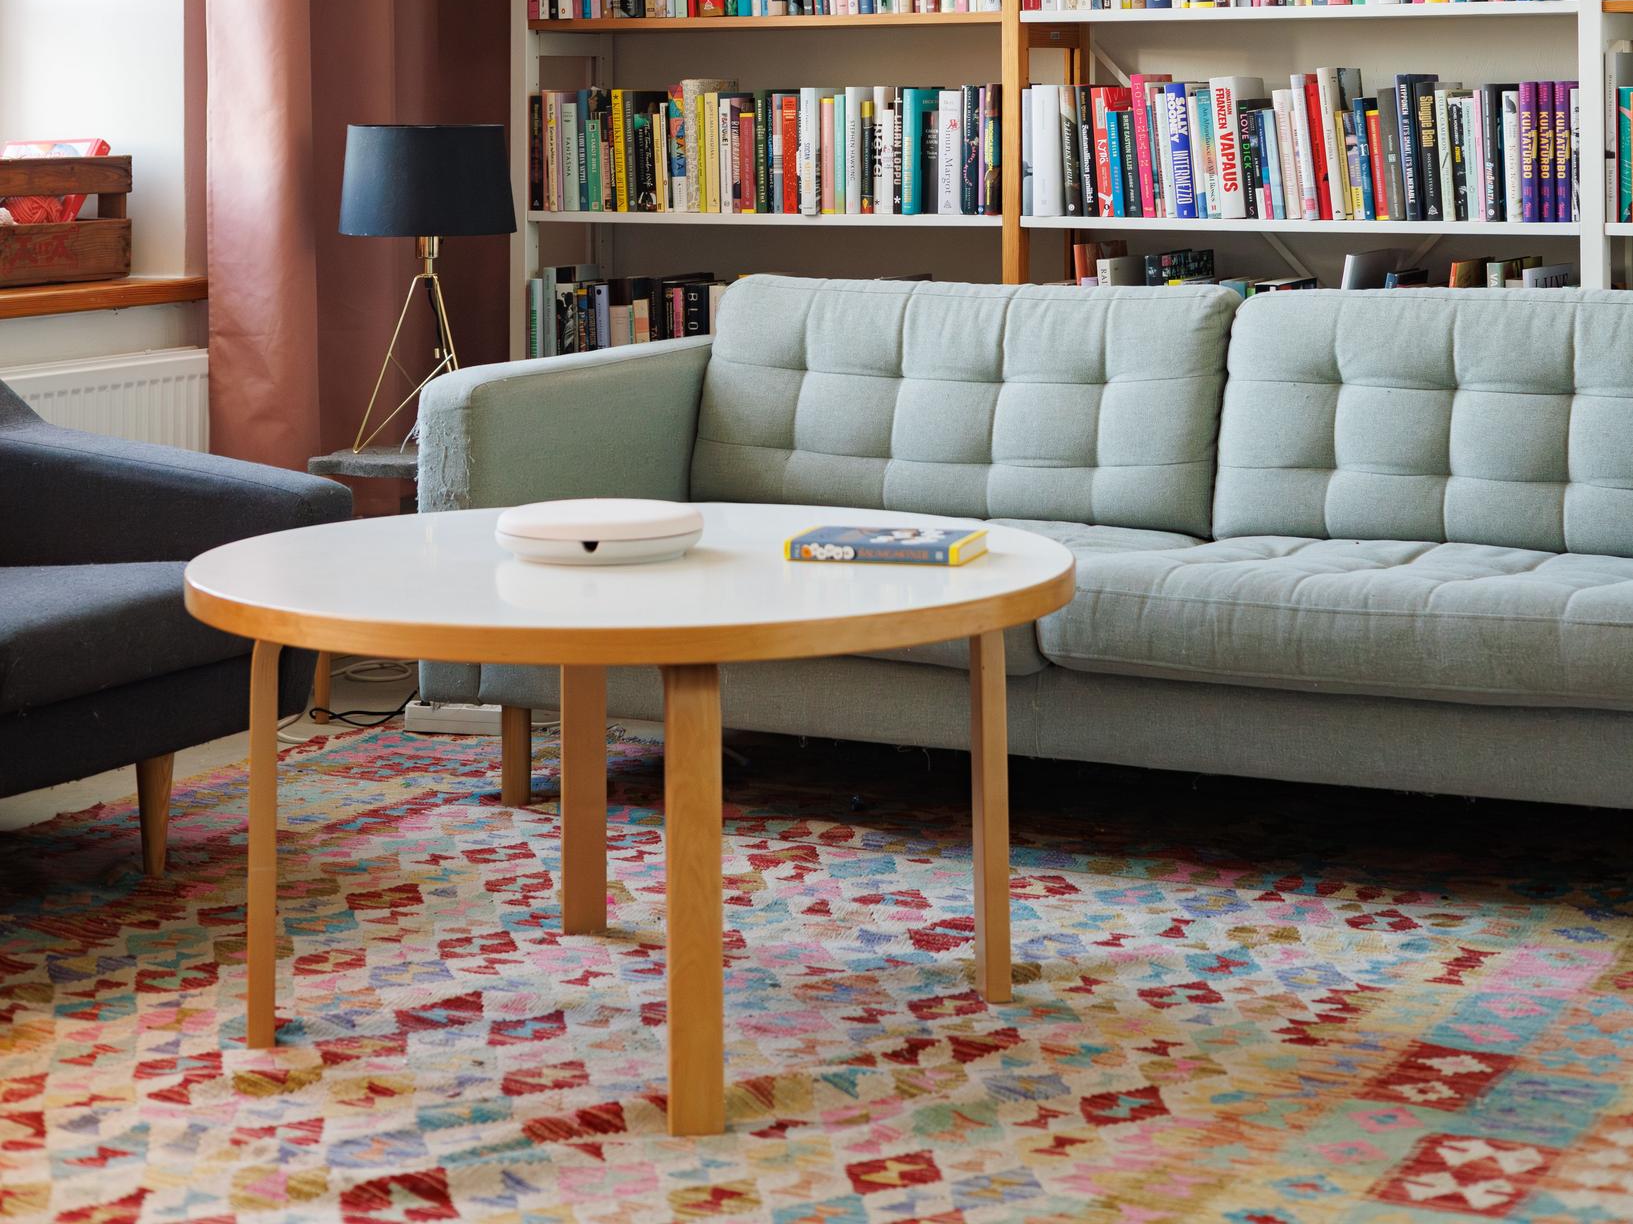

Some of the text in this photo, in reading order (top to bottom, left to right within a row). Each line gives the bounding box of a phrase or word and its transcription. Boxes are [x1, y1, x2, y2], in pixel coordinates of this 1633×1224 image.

[1167, 92, 1179, 143] ROONEY
[1176, 97, 1188, 136] SALLY
[1216, 88, 1227, 129] FRANZEN
[1419, 96, 1435, 147] Shuggie Bain
[1082, 125, 1093, 203] Saatanallinen paniikki
[1220, 132, 1238, 192] VAPAUS
[1240, 114, 1252, 169] LOVE DICK
[1522, 111, 1532, 179] KULTATURBO
[1540, 111, 1550, 179] KULTATURBO
[1555, 111, 1566, 179] KULTATURBO
[942, 158, 952, 194] Margot
[1172, 150, 1193, 205] INTERMEZZO
[1406, 168, 1415, 203] VULNERABLE
